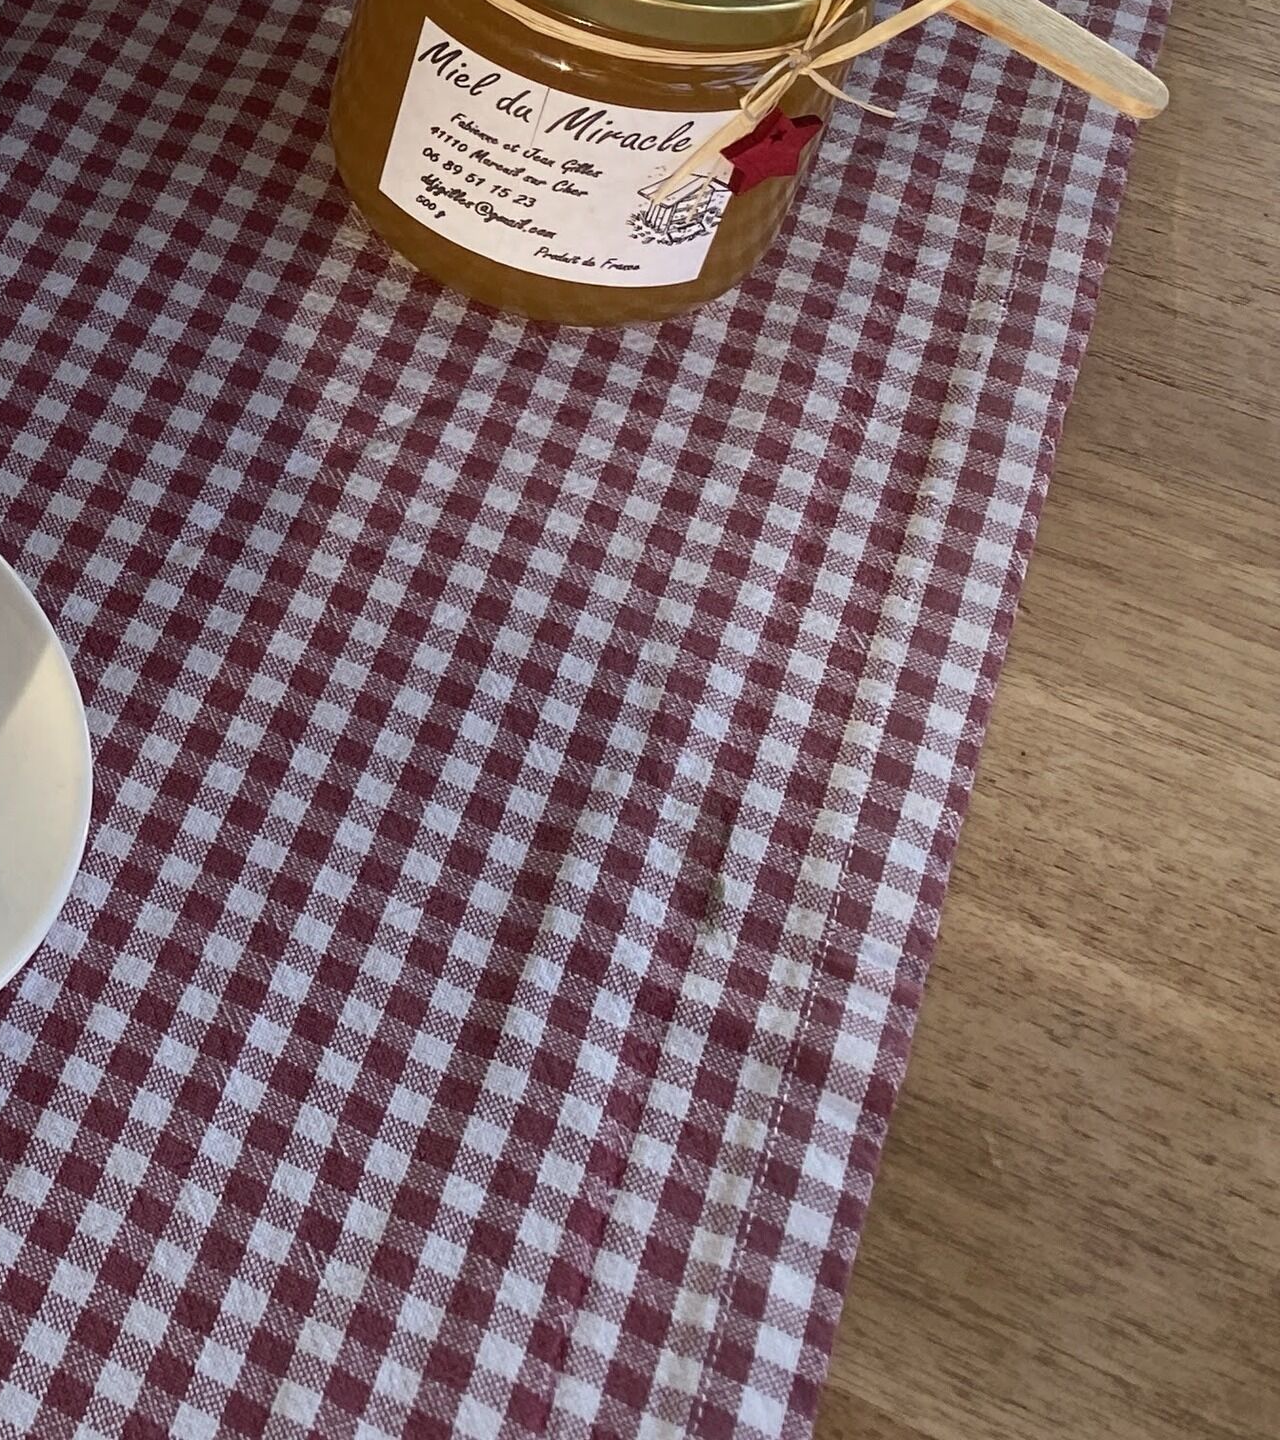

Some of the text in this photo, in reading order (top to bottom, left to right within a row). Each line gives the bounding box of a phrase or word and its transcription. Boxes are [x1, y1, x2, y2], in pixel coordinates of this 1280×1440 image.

[418, 41, 501, 96] Miel
[544, 107, 694, 152] Miracle
[422, 147, 440, 162] 06
[442, 160, 463, 175] 89
[490, 184, 512, 198] 15
[512, 194, 537, 208] 23
[430, 126, 468, 152] 41110
[551, 180, 589, 197] Cher
[523, 147, 556, 167] Jean
[561, 159, 603, 178] Gilles
[415, 194, 437, 211] 500
